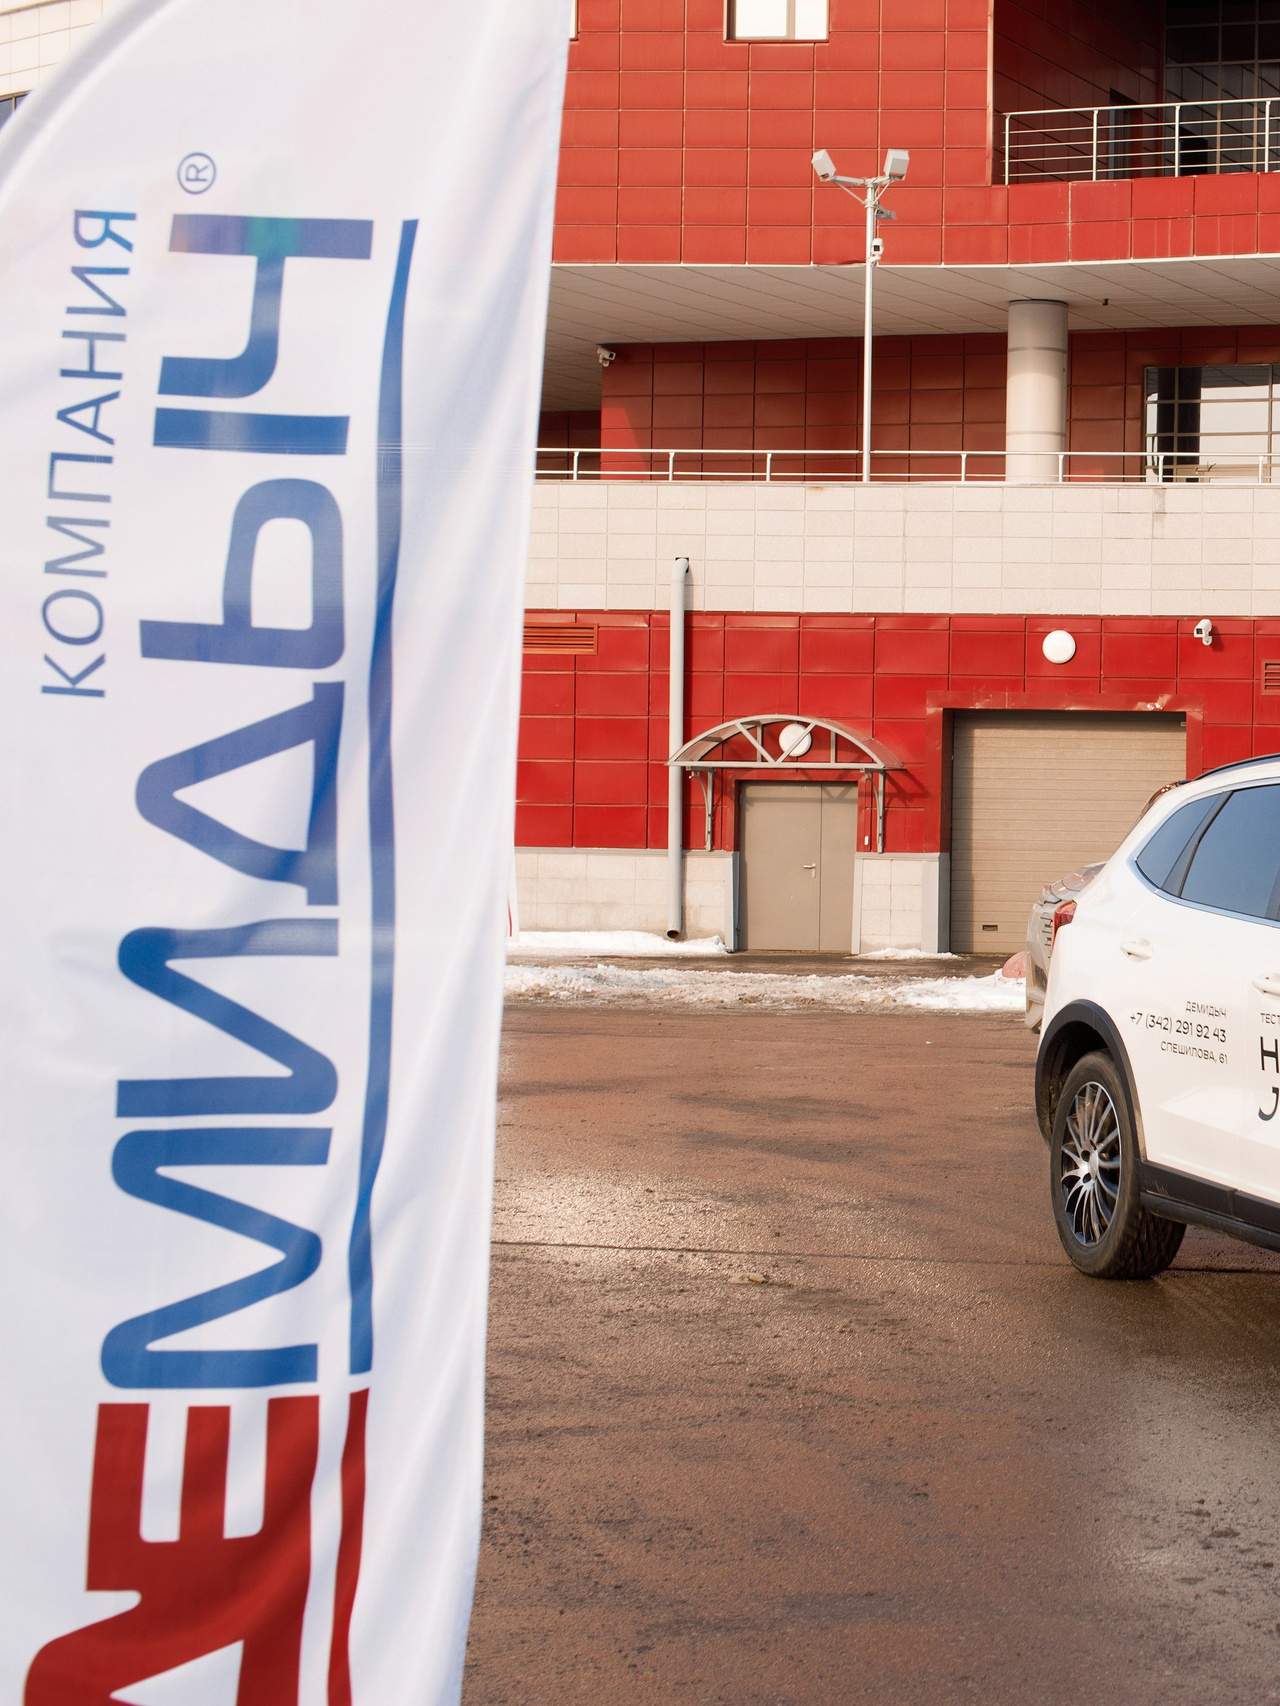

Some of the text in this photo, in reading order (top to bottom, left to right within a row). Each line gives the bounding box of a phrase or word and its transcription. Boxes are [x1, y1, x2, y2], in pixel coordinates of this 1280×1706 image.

[41, 209, 138, 699] КОМПАНИЯ
[1185, 1001, 1227, 1019] ДЕМИДЫЧ
[1130, 1012, 1227, 1043] +7 (342) 291 92 43
[1219, 1053, 1228, 1064] 61
